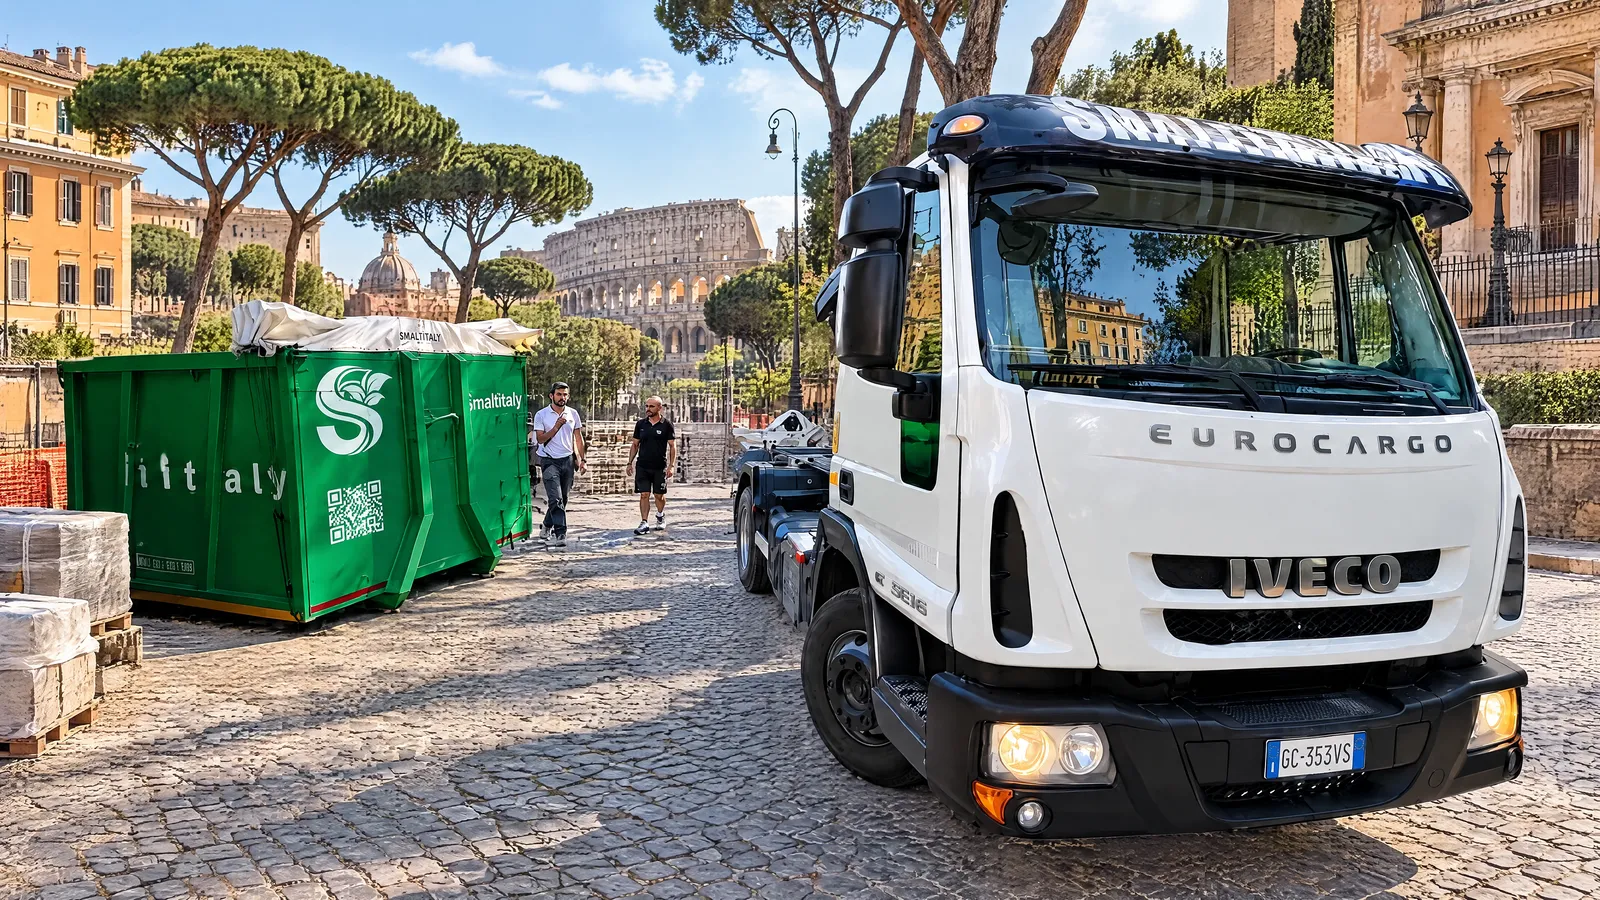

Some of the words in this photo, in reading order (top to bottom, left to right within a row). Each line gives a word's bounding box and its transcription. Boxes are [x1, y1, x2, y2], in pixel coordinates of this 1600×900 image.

[399, 331, 441, 342] SMALTITALY
[1148, 423, 1453, 455] EUROCARGO
[1225, 554, 1400, 598] IVECO
[1281, 742, 1351, 769] GC-353VS
